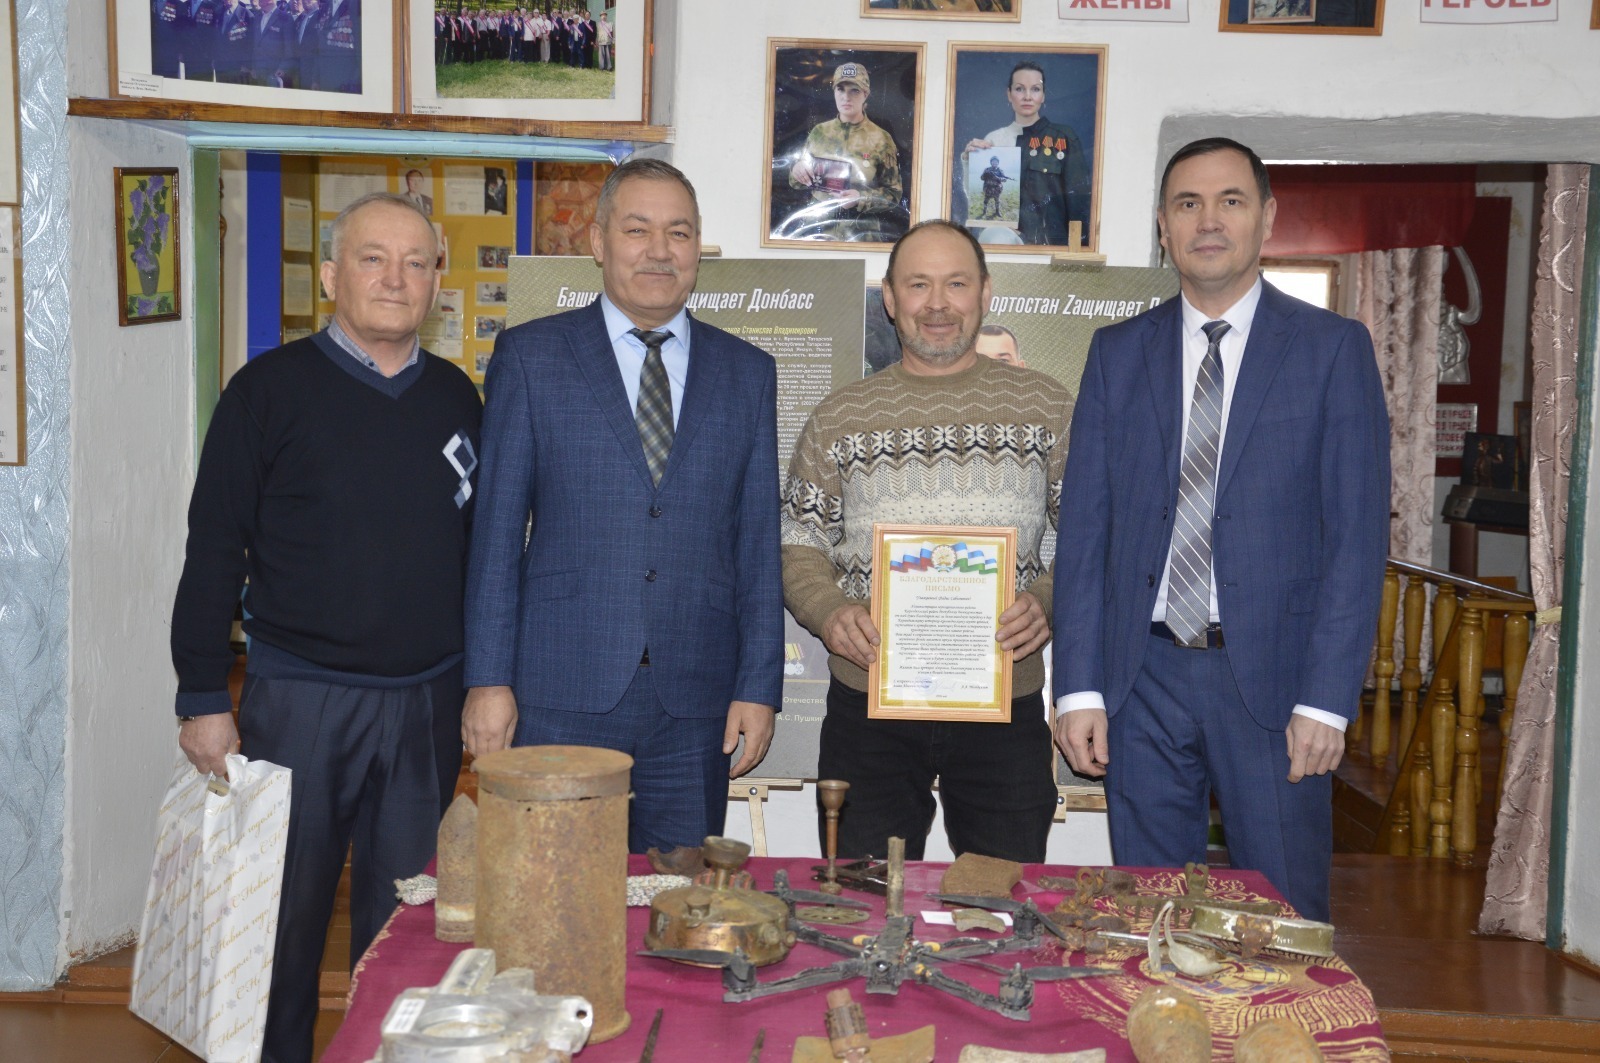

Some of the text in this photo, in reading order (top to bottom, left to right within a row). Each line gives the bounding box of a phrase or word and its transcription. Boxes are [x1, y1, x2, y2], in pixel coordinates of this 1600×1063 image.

[685, 291, 747, 313] щищает
[746, 288, 815, 313] Донбасс
[989, 294, 1061, 317] ортостан
[1062, 294, 1145, 321] Zащищает
[899, 575, 987, 585] БЛАГОДАРСТВЕННОЕ
[783, 696, 827, 705] Отечество,
